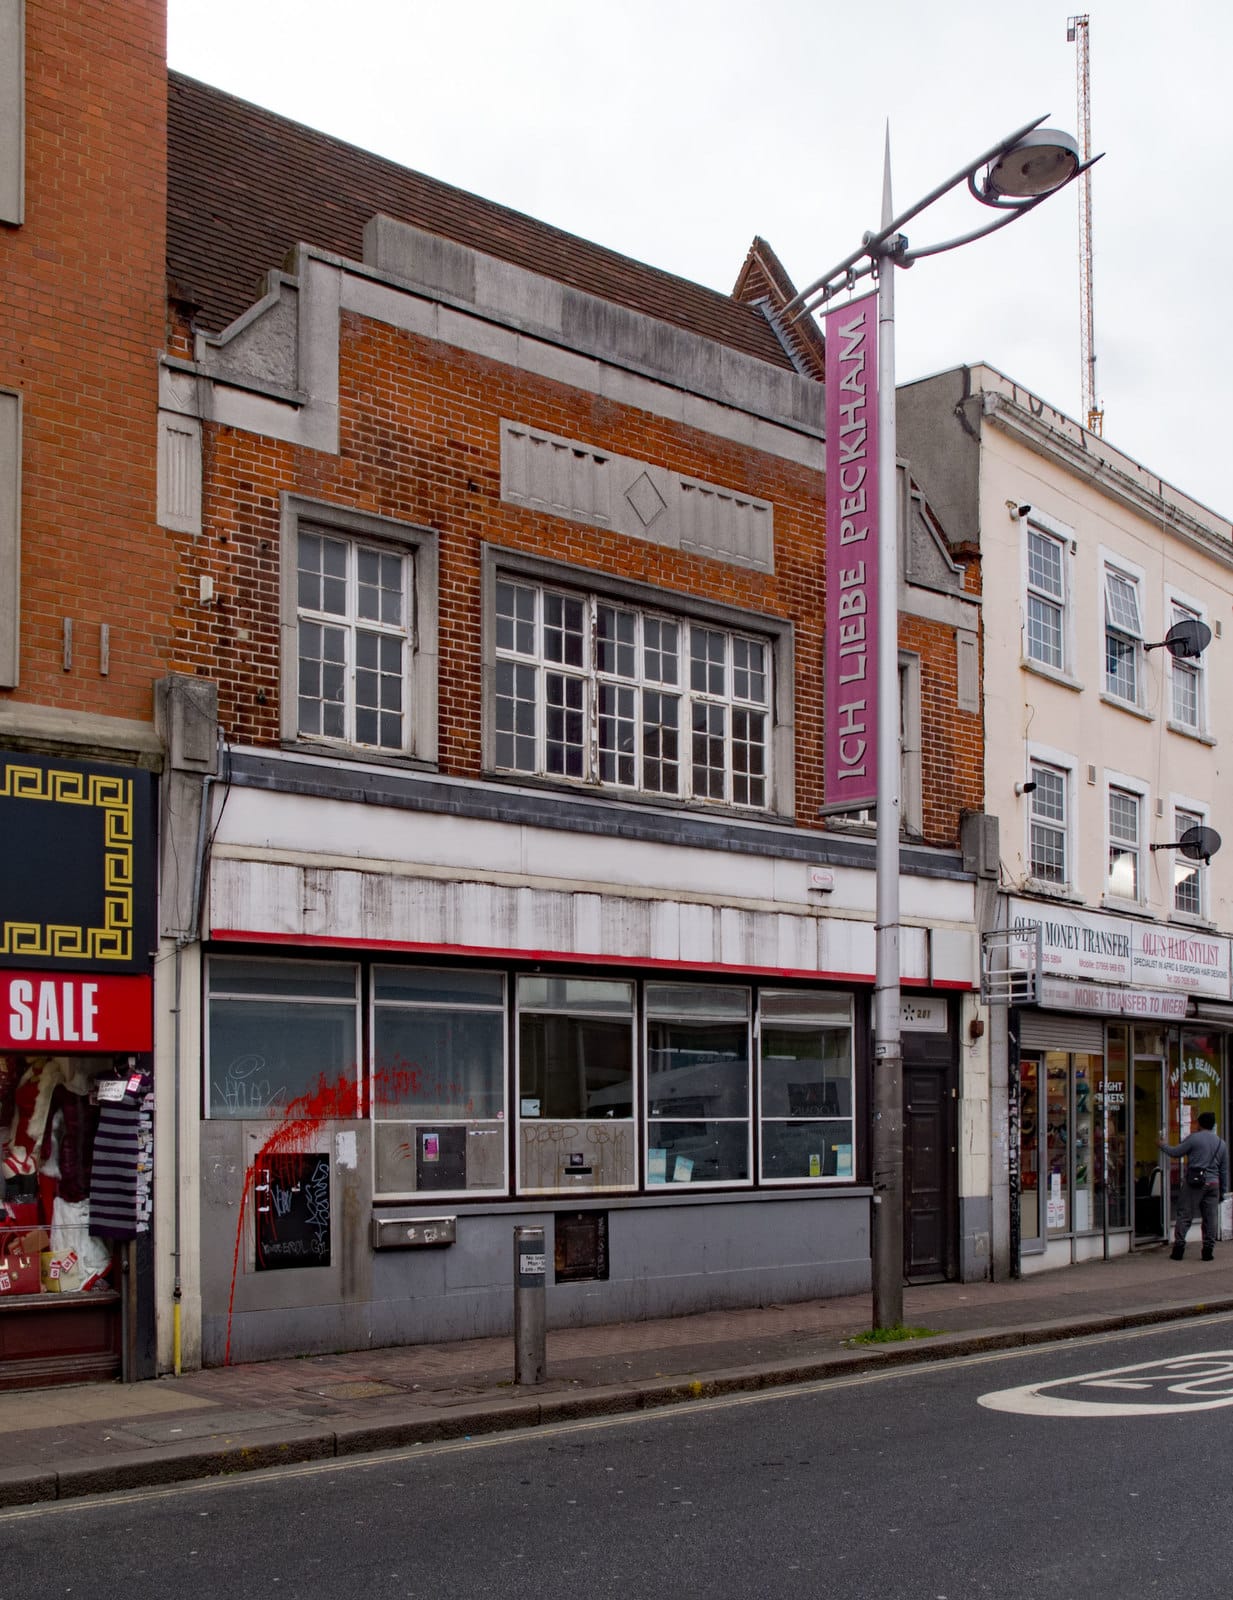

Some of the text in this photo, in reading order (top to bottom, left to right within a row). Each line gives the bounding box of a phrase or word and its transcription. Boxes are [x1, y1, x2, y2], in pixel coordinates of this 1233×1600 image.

[838, 311, 868, 781] ICH LIEBE PECKHAM
[1045, 921, 1080, 951] MONEY
[1082, 928, 1130, 958] TRANSFER
[1142, 932, 1219, 967] OLU'S HAIR STYLIST
[9, 979, 99, 1042] SALE
[1074, 988, 1103, 1007] MONEY
[1106, 991, 1147, 1012] TRANSFER
[1149, 997, 1159, 1013] TO
[1195, 1057, 1221, 1087] BEAUTY
[1181, 1082, 1210, 1098] SALON
